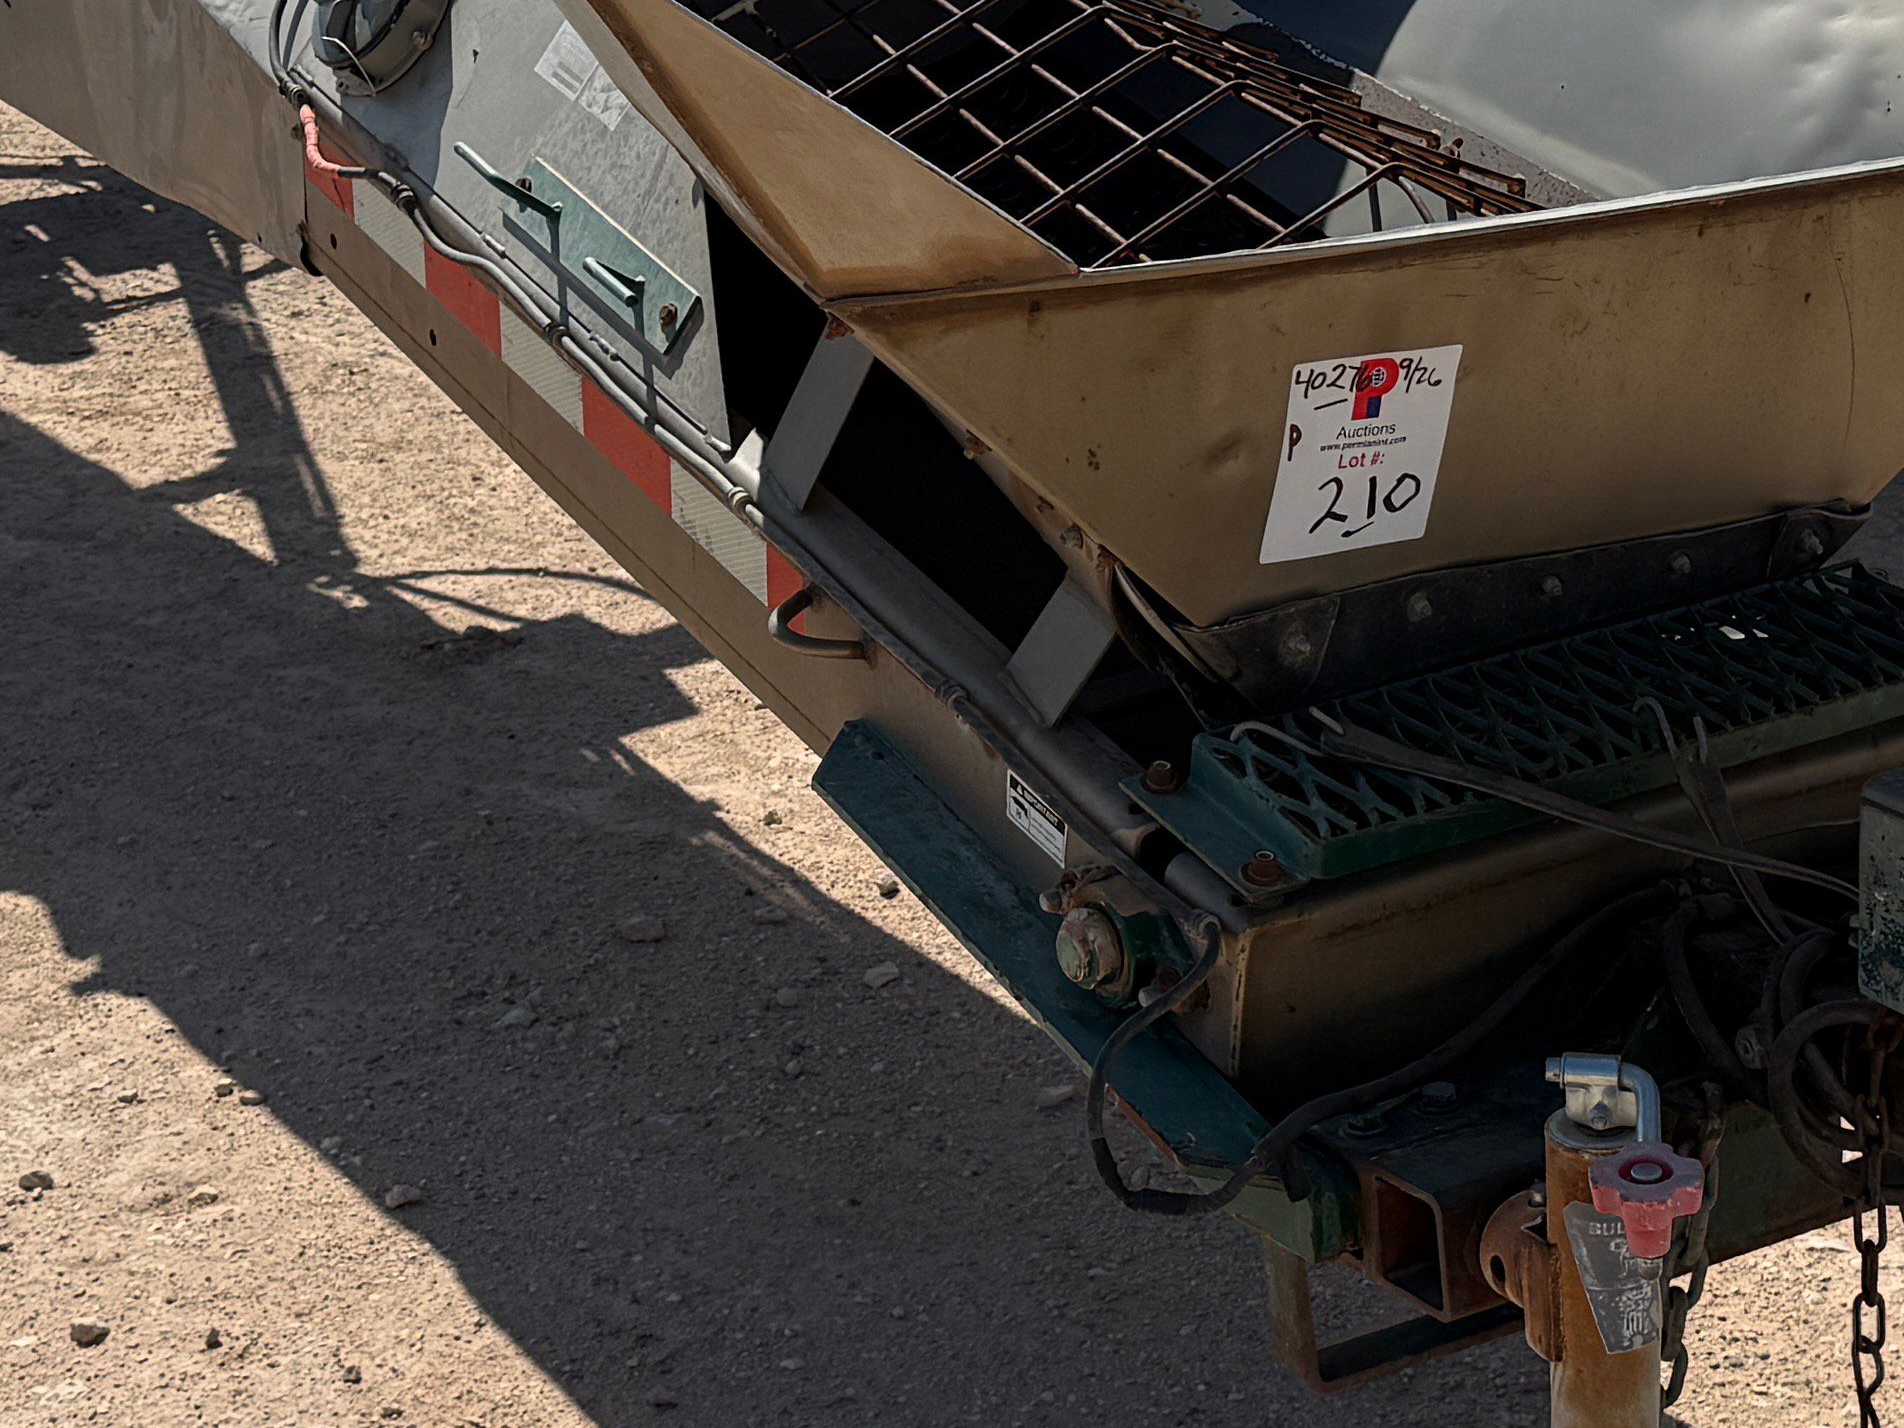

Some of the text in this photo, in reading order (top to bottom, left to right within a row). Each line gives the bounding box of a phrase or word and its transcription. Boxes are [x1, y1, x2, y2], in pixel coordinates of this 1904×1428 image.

[1336, 422, 1396, 440] Auctions
[1338, 450, 1386, 470] Lot #:
[1308, 472, 1422, 535] 210
